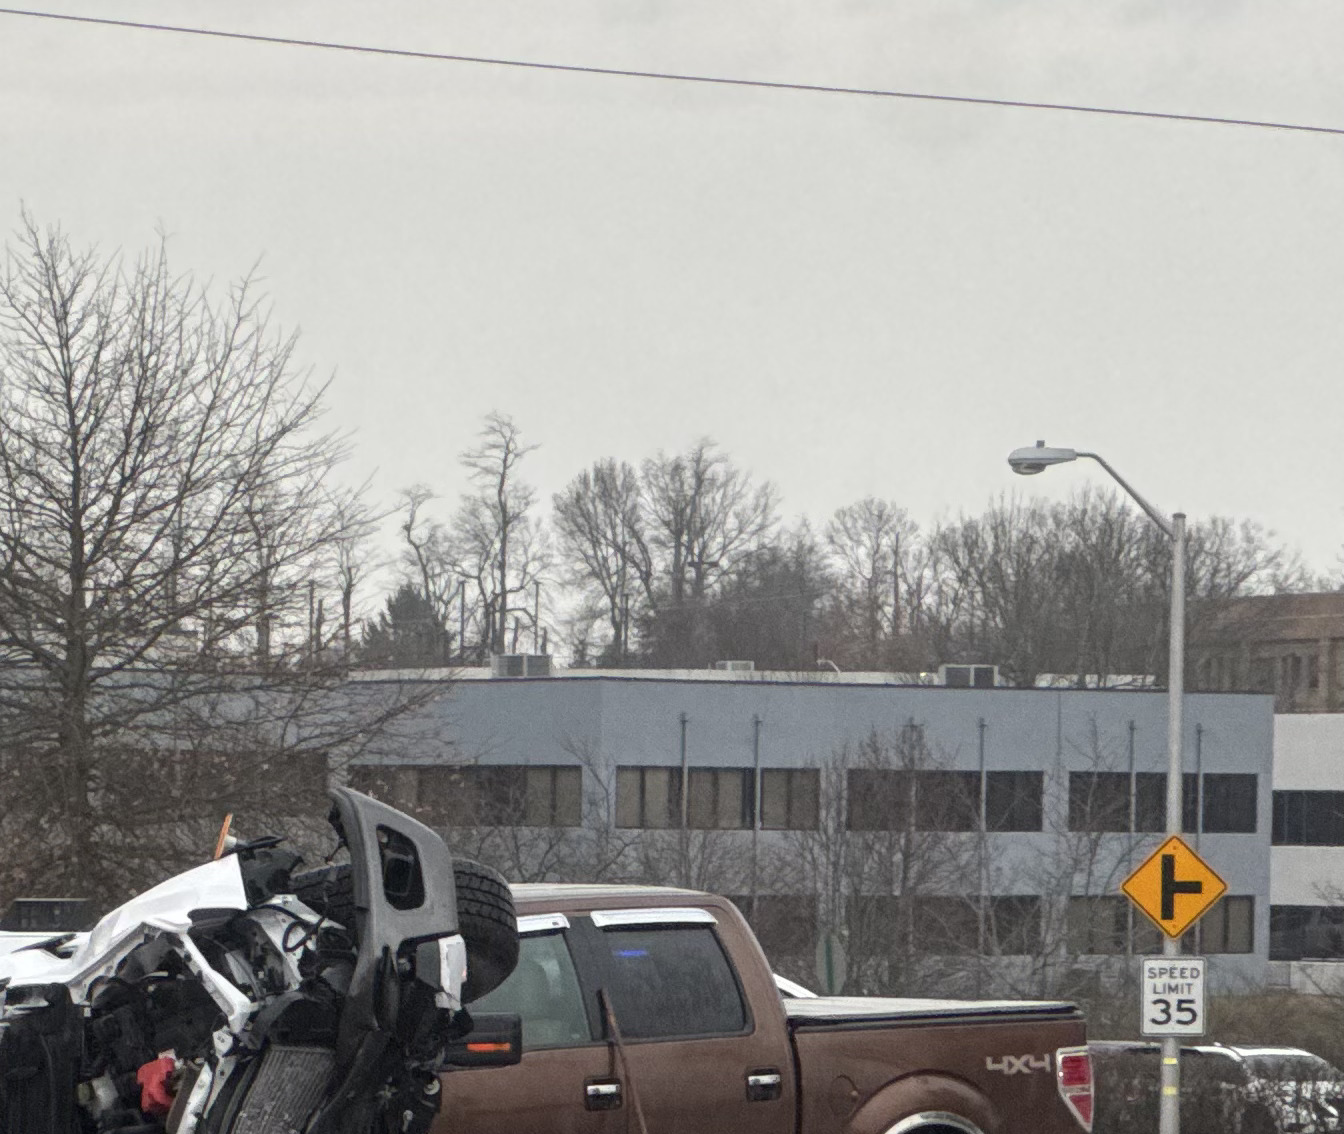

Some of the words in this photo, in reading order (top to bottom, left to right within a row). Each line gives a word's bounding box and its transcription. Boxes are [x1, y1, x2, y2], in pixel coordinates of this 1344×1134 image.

[1147, 967, 1201, 980] SPEED
[1152, 983, 1194, 995] LIMIT
[1150, 998, 1198, 1026] 35
